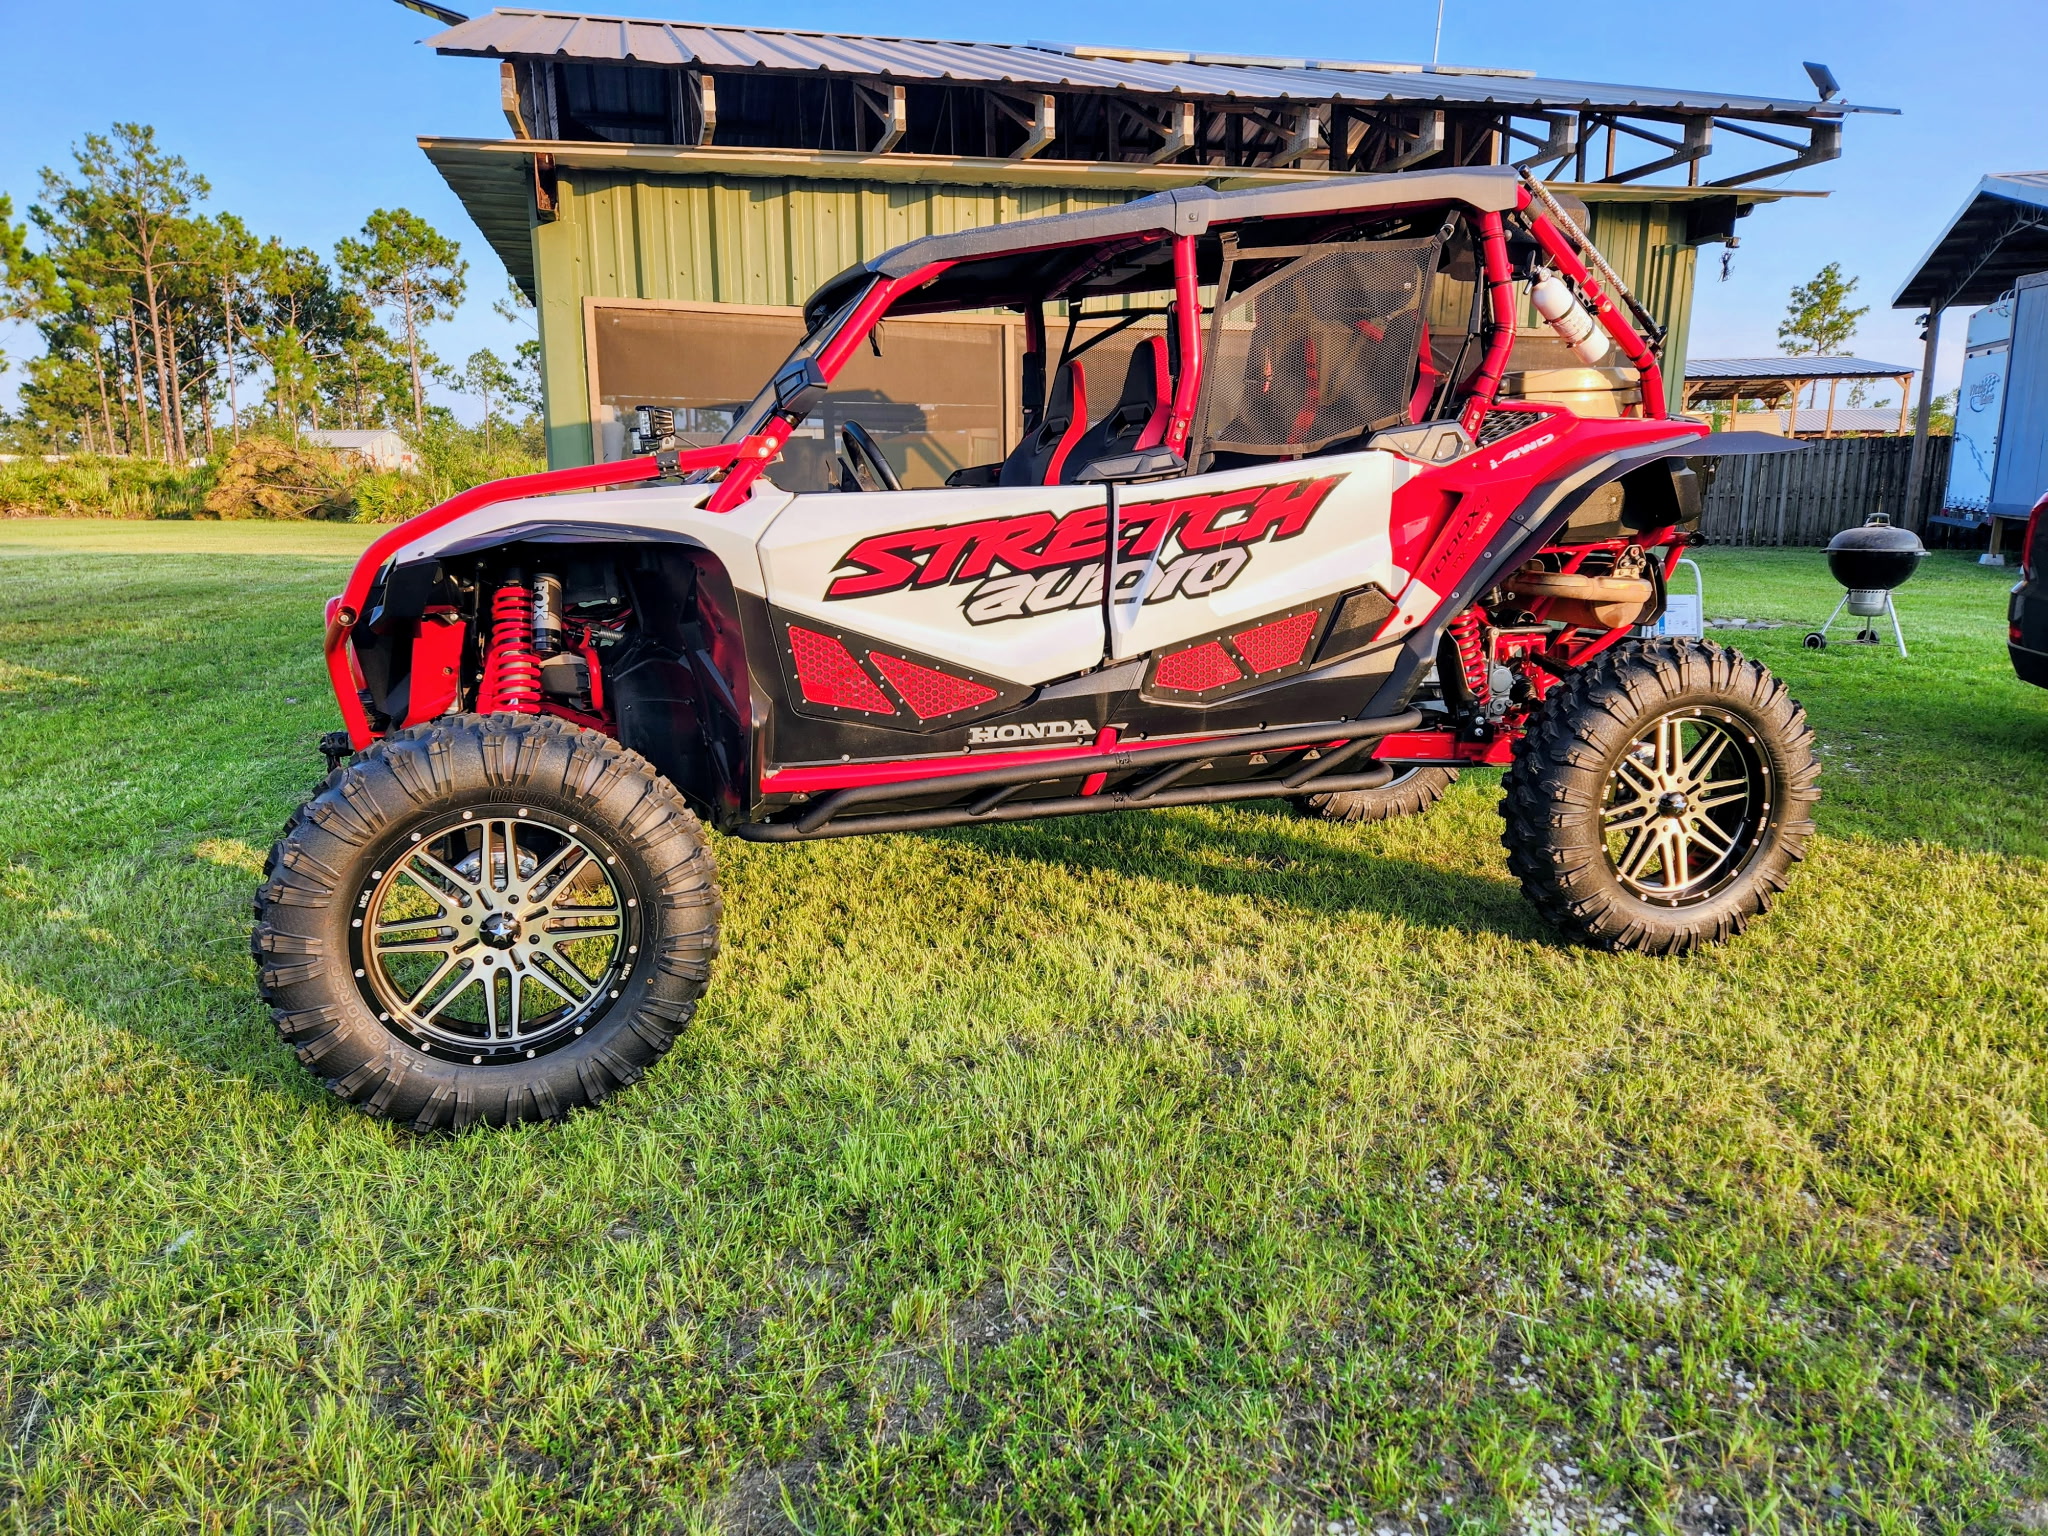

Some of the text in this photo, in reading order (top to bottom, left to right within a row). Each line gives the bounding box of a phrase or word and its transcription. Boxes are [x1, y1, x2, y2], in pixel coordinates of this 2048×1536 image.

[1489, 433, 1555, 470] i-4WD
[825, 474, 1350, 601] STRETCH
[533, 580, 549, 620] FOX
[968, 719, 1097, 744] HONDA
[358, 890, 372, 909] MSA
[620, 963, 632, 981] MSA
